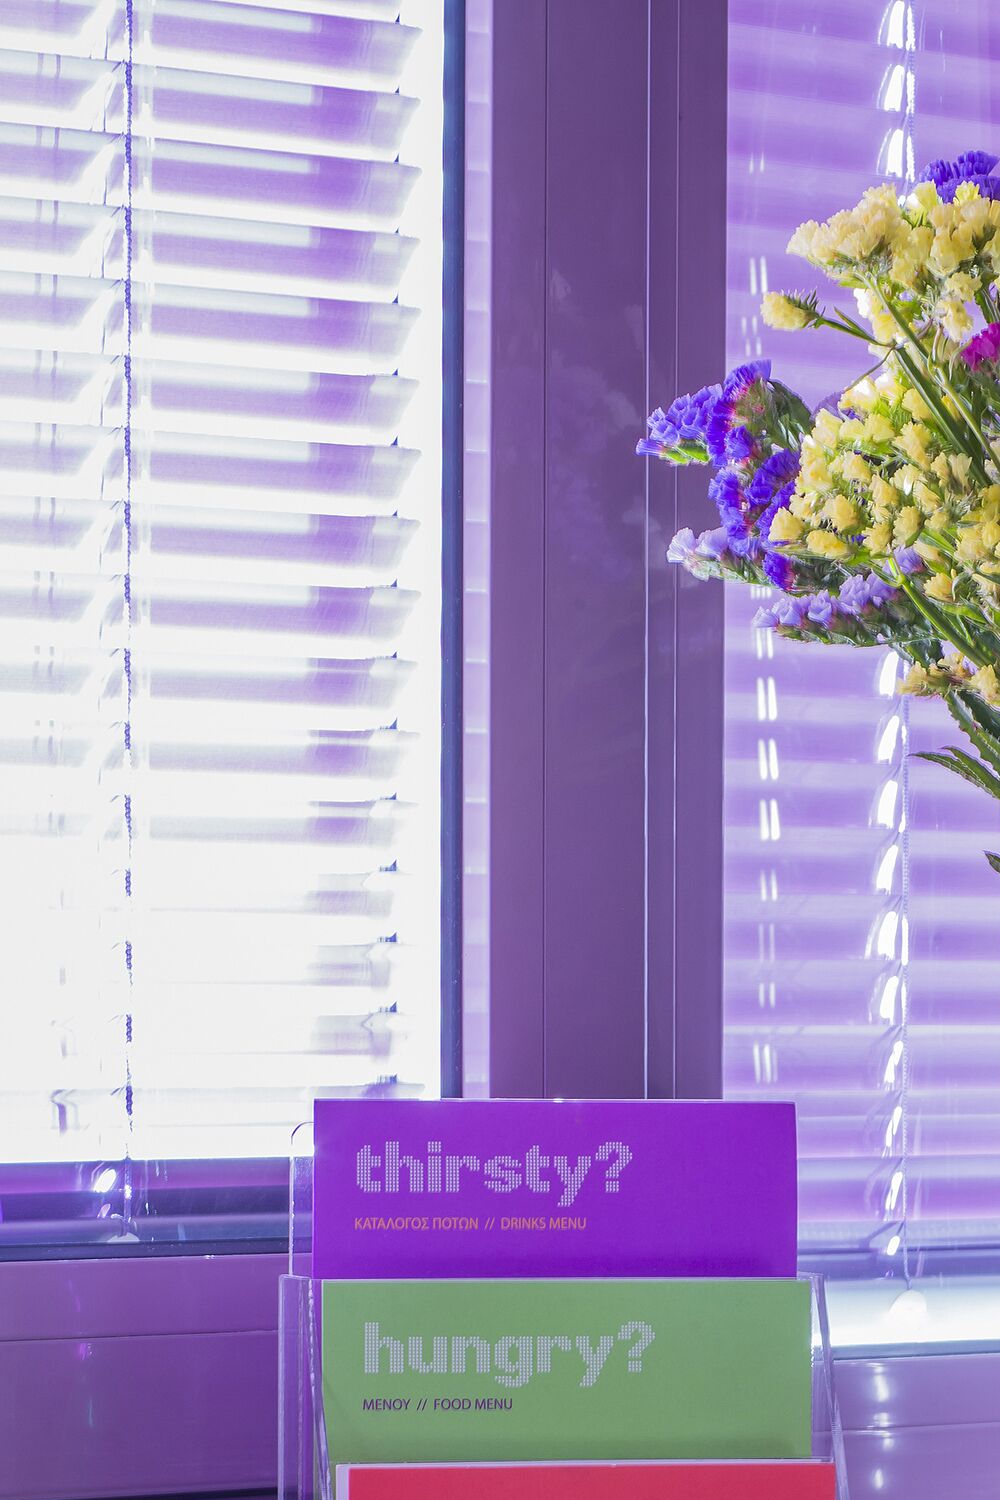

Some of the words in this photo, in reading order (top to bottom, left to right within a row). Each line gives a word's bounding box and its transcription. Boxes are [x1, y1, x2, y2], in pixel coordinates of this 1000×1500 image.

[355, 1140, 633, 1208] thirsty?
[354, 1216, 430, 1230] ΚΑΤΑΛΟΓΟΣ
[432, 1216, 479, 1230] ΠΟΤΩΝ
[500, 1216, 546, 1230] DRINKS
[549, 1216, 587, 1230] MENU
[363, 1320, 656, 1388] hungry?
[433, 1398, 472, 1410] FOOD
[474, 1398, 513, 1410] MENU
